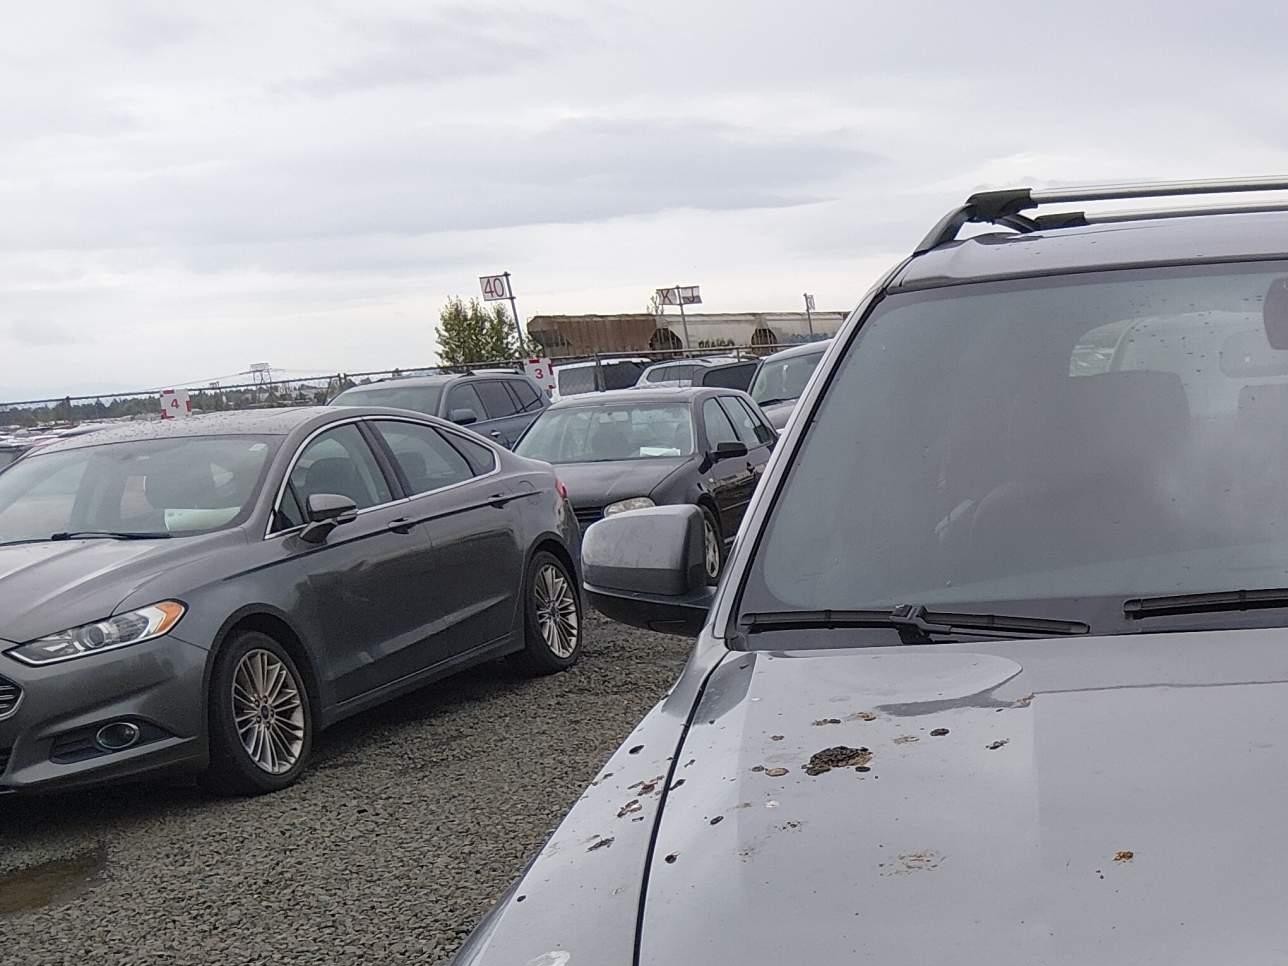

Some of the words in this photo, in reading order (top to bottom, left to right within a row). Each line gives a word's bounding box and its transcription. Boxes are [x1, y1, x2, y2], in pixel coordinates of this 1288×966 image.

[484, 278, 505, 298] 40
[660, 289, 674, 304] K
[534, 368, 544, 380] 3
[171, 398, 179, 409] 4
